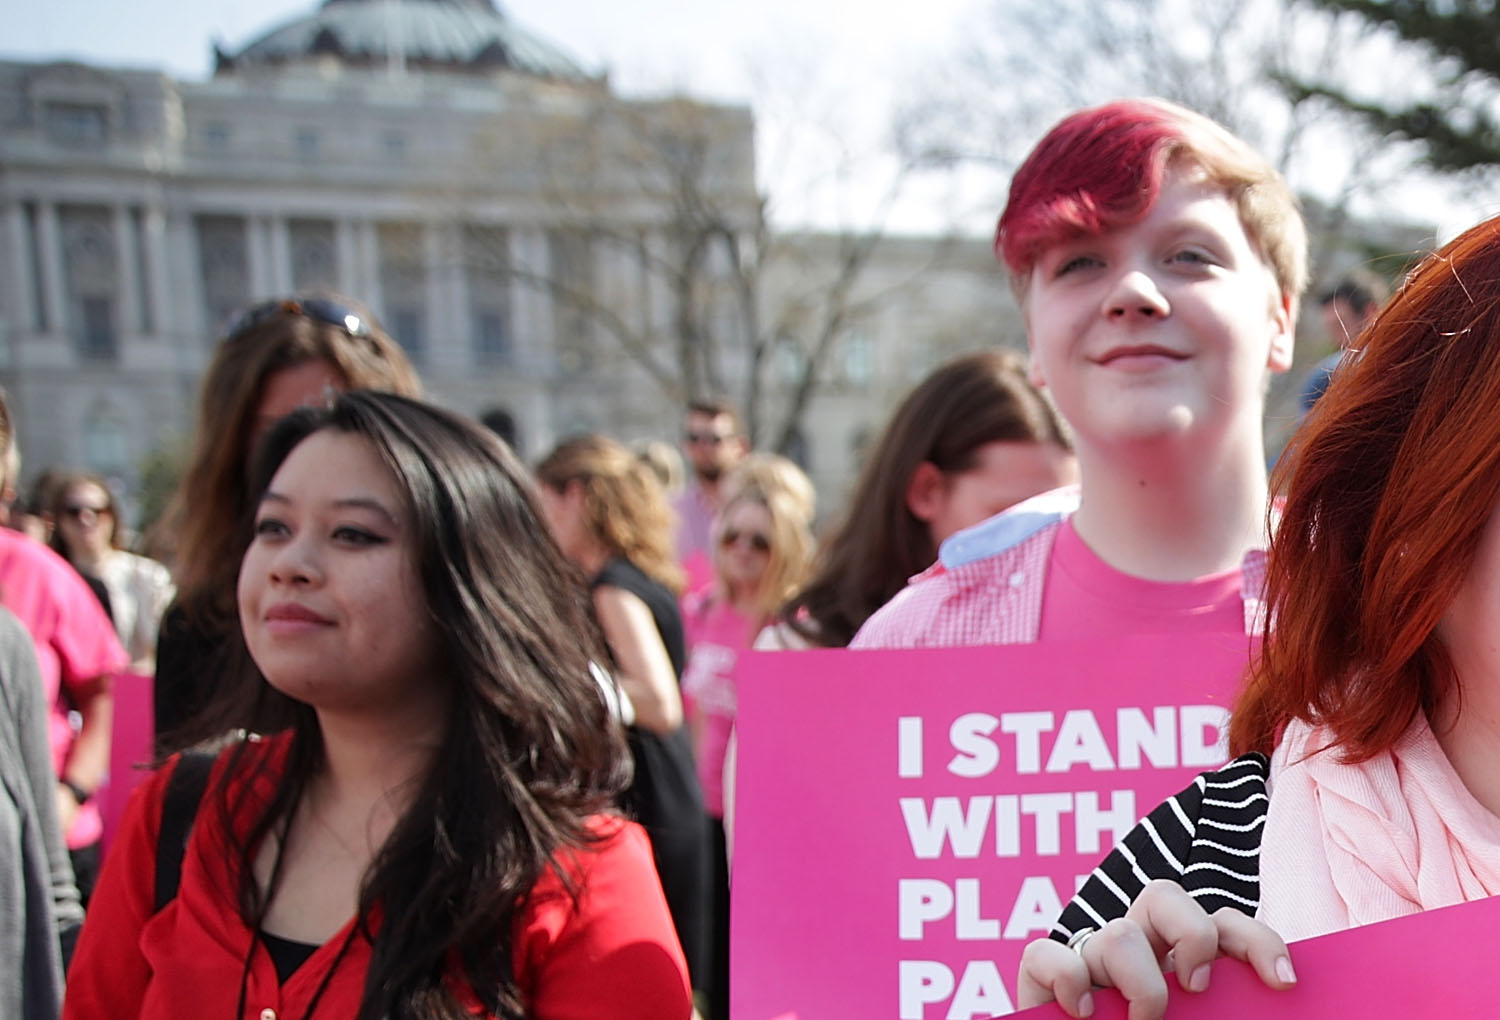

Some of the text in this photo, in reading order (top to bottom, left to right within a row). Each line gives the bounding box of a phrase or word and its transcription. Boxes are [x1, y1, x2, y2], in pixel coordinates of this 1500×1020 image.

[899, 705, 1232, 778] I STAND
[900, 789, 1136, 858] WITH
